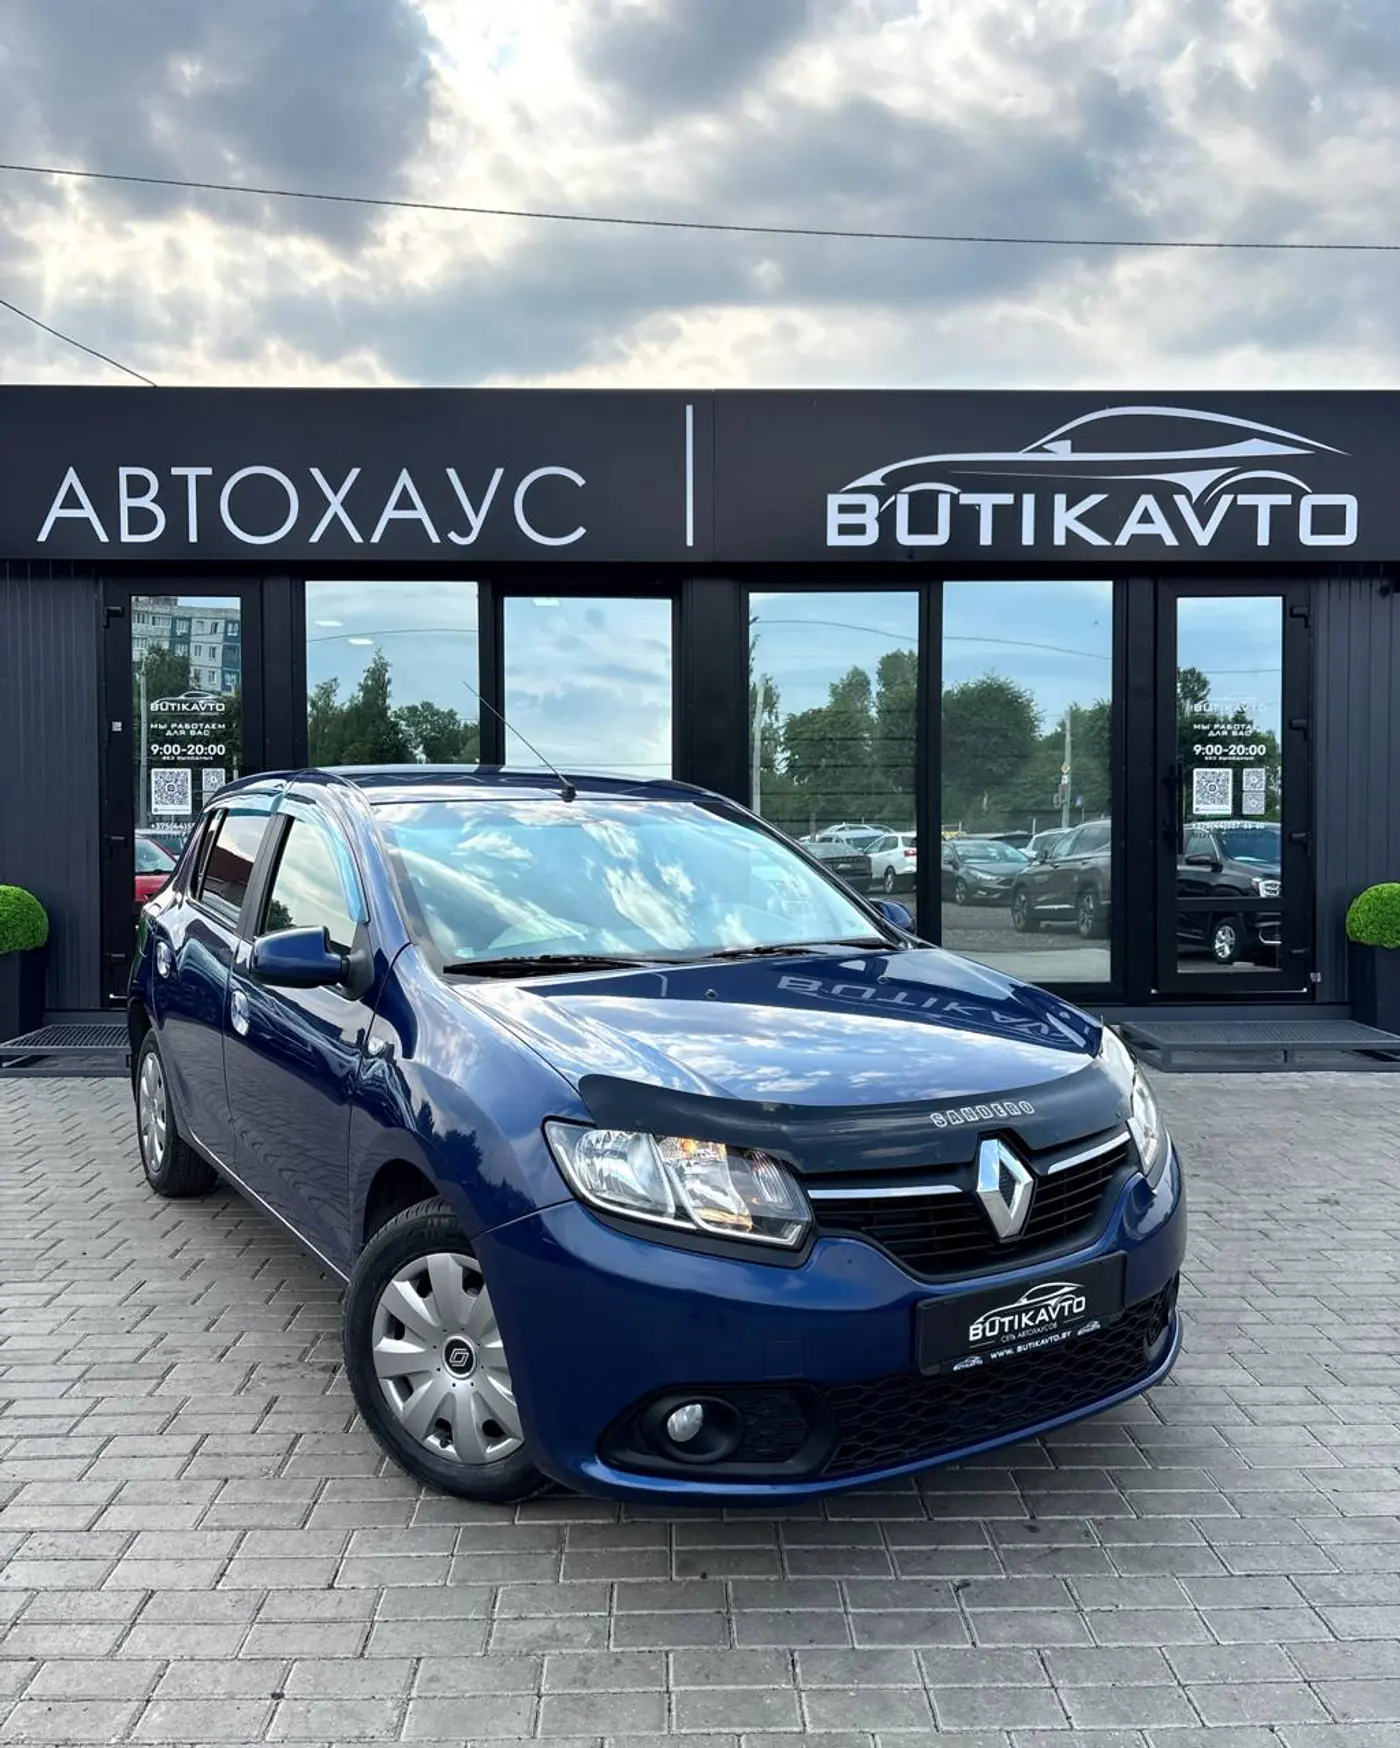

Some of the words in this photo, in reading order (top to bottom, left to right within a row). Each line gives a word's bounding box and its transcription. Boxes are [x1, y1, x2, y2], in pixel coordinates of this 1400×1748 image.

[36, 465, 587, 547] АВТОХАУС
[825, 493, 1359, 547] BUTIKAVTO
[150, 703, 226, 712] BUTIKAVTO
[150, 744, 226, 756] 9:00-20:00
[1193, 744, 1267, 756] 9:00-20:00
[930, 1100, 1036, 1128] SANDERO
[968, 1296, 1086, 1342] BUTIKAVTO
